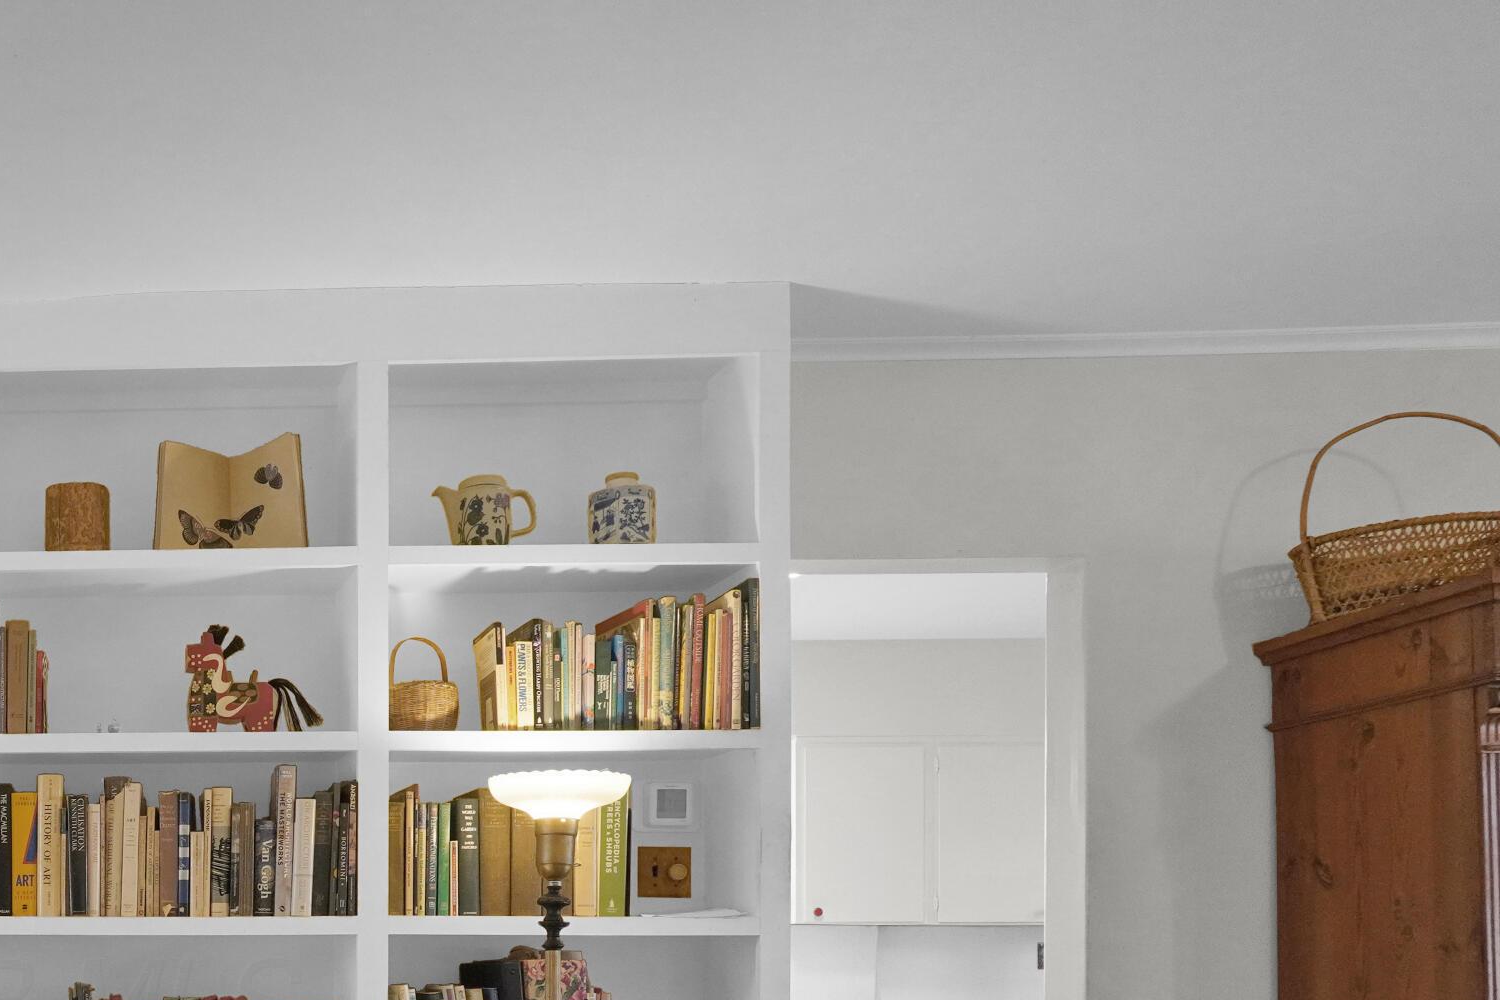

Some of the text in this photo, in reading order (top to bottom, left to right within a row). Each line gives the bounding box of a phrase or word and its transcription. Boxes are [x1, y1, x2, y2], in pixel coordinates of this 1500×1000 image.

[517, 644, 526, 669] PLANTS
[695, 629, 703, 664] OUTSIDE
[518, 680, 527, 712] FLOWERS
[0, 806, 8, 844] MACMILLAN
[77, 798, 85, 851] CIVILISATION
[613, 801, 621, 863] ENCYCLOPEDIA
[44, 850, 51, 863] OF
[284, 820, 292, 878] ARCHITECTURE
[339, 837, 347, 880] BORROMINI
[16, 874, 35, 886] ART
[43, 867, 51, 886] ART
[258, 839, 273, 899] Van Gogh
